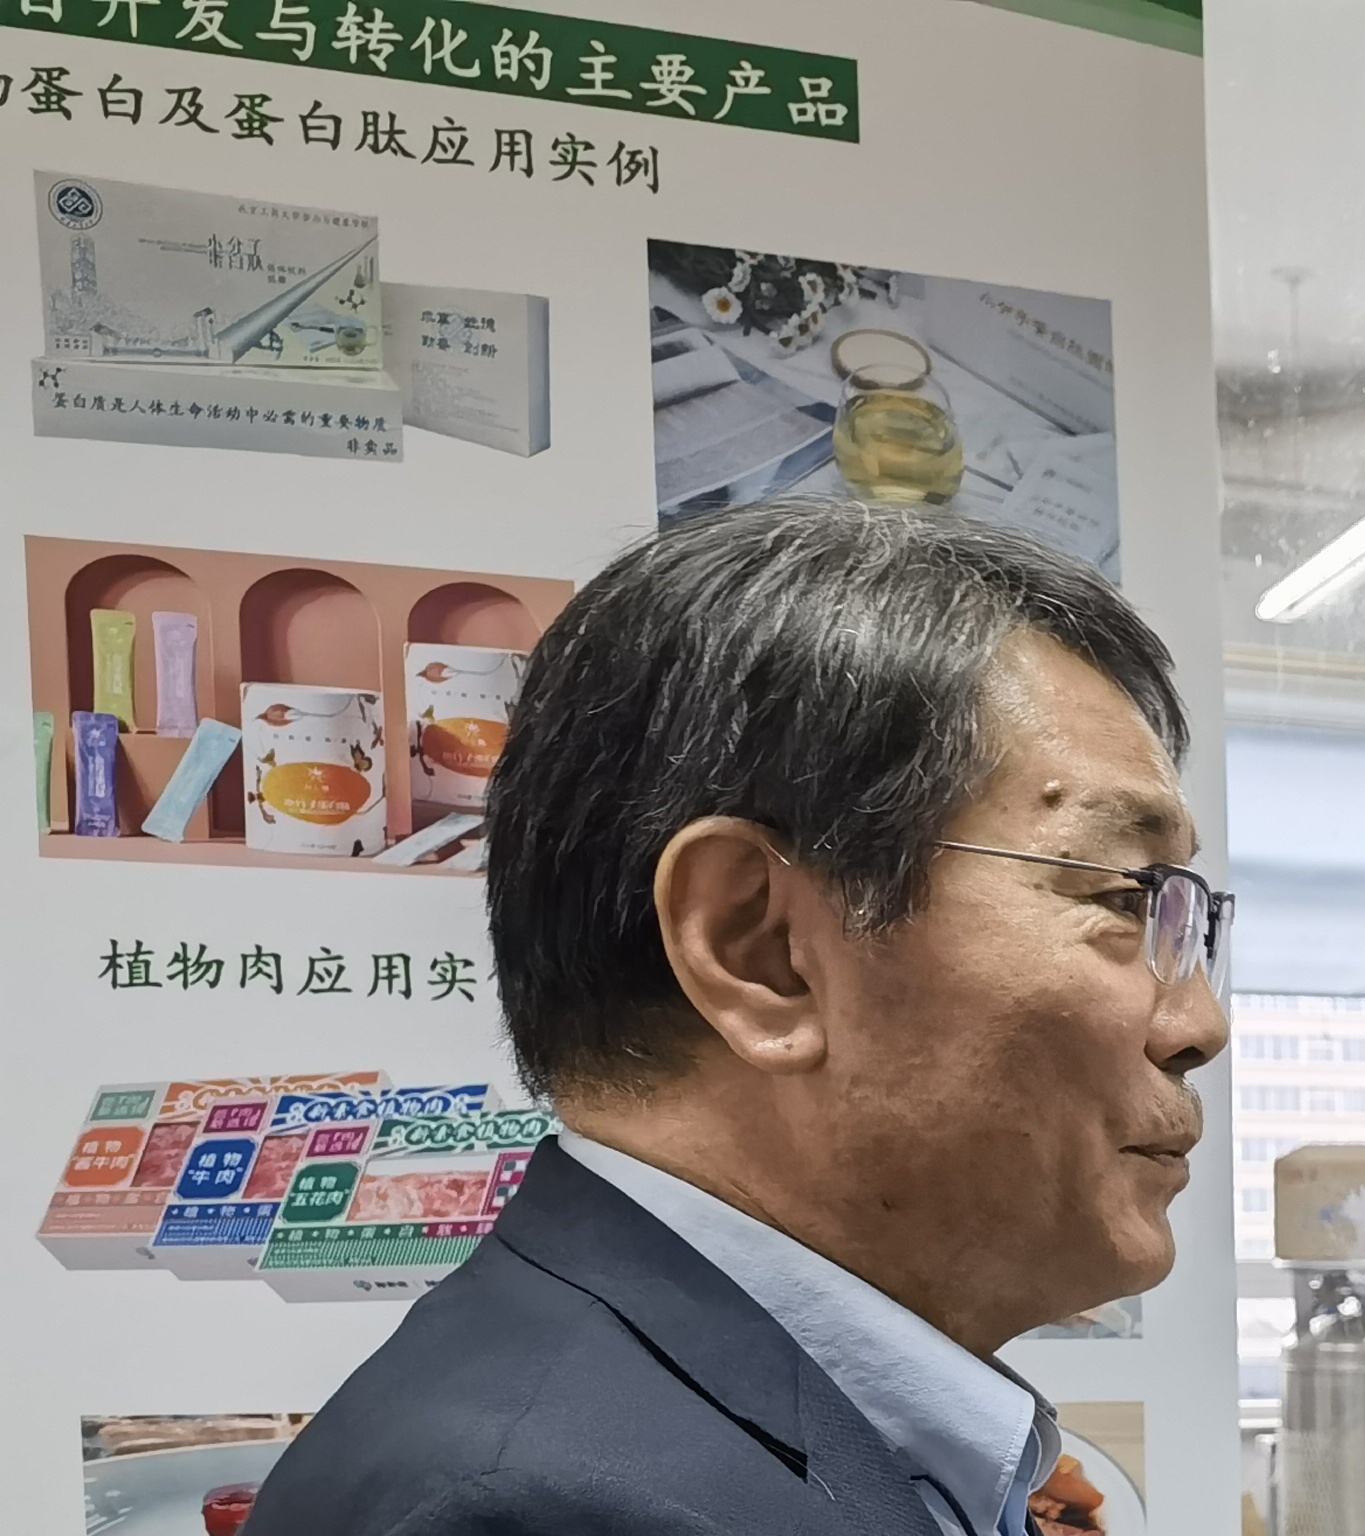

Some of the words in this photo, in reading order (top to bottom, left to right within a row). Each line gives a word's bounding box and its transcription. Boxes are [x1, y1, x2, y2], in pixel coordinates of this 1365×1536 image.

[0, 66, 660, 195] 蛋白及蛋白肽应用实例
[97, 938, 499, 1003] 植物肉应用实
